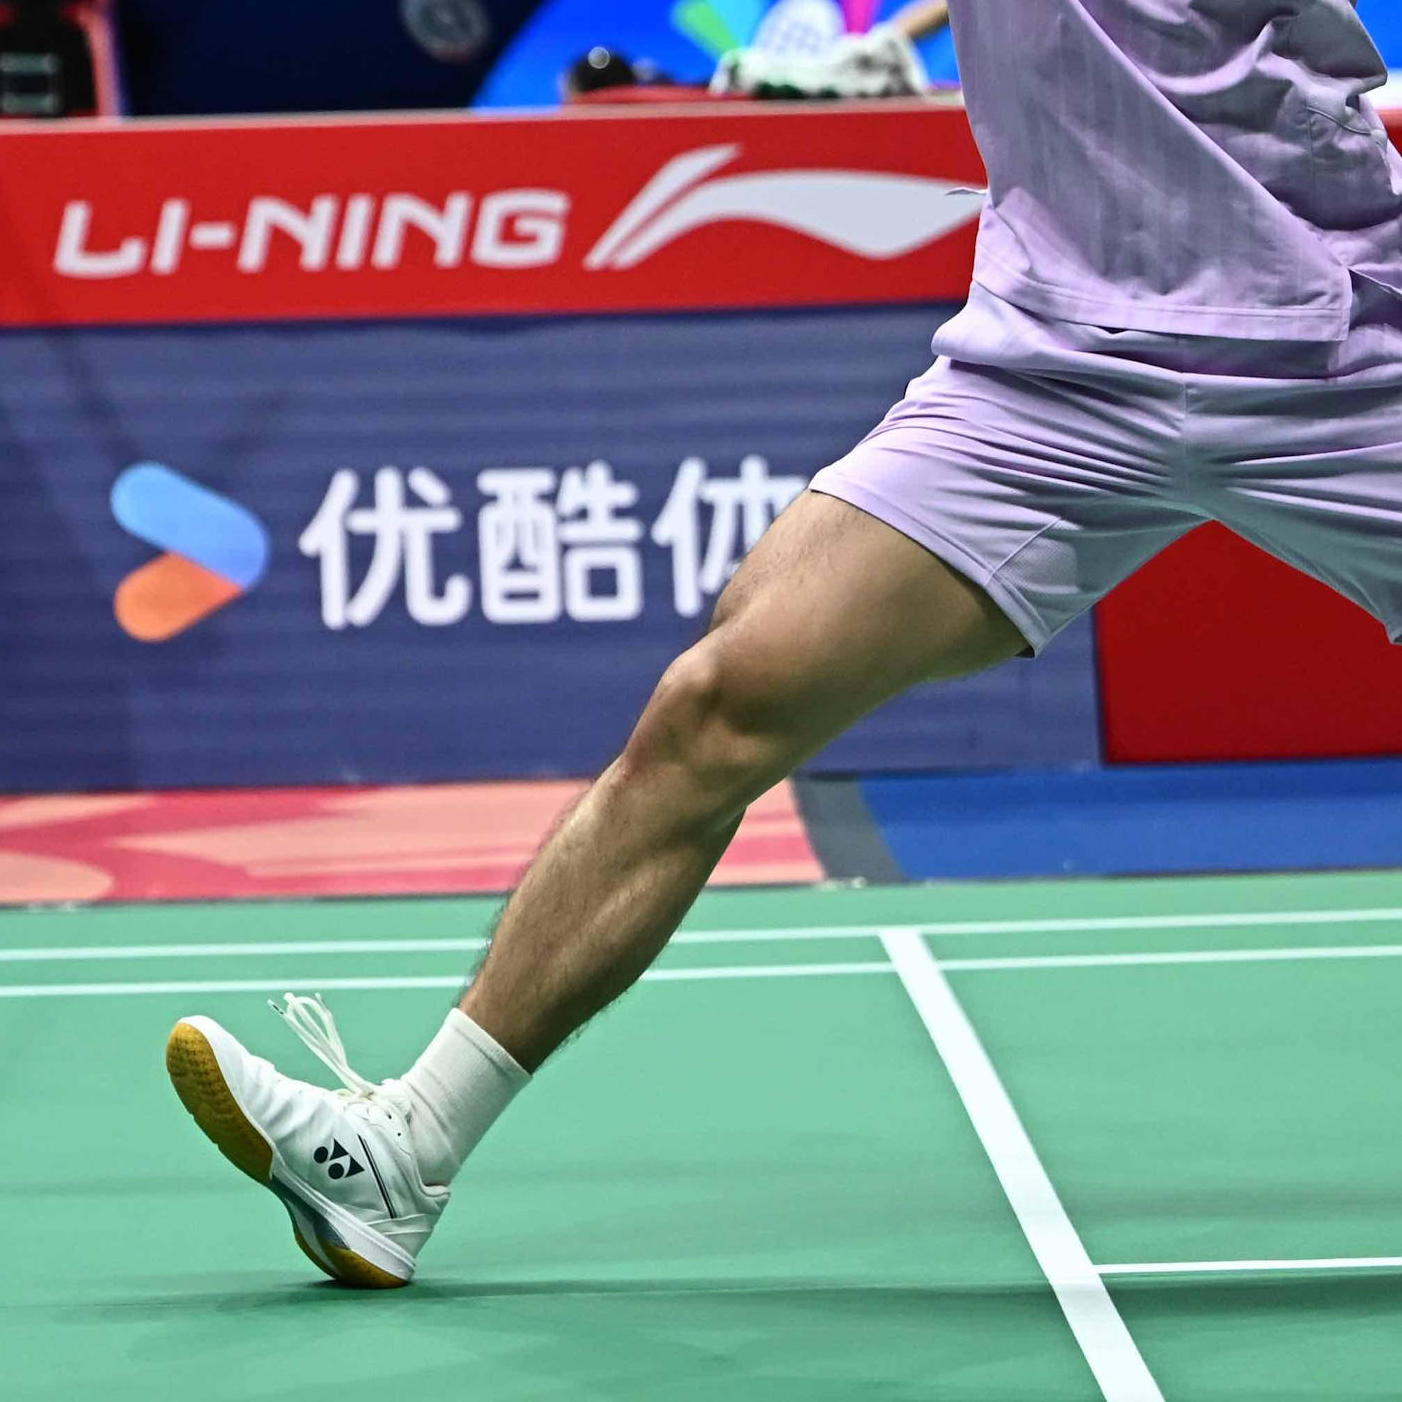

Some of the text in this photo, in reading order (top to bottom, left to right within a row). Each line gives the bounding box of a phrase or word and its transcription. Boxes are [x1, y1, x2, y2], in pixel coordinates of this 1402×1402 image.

[53, 188, 571, 280] LI-NING
[297, 455, 804, 630] 优酷体
